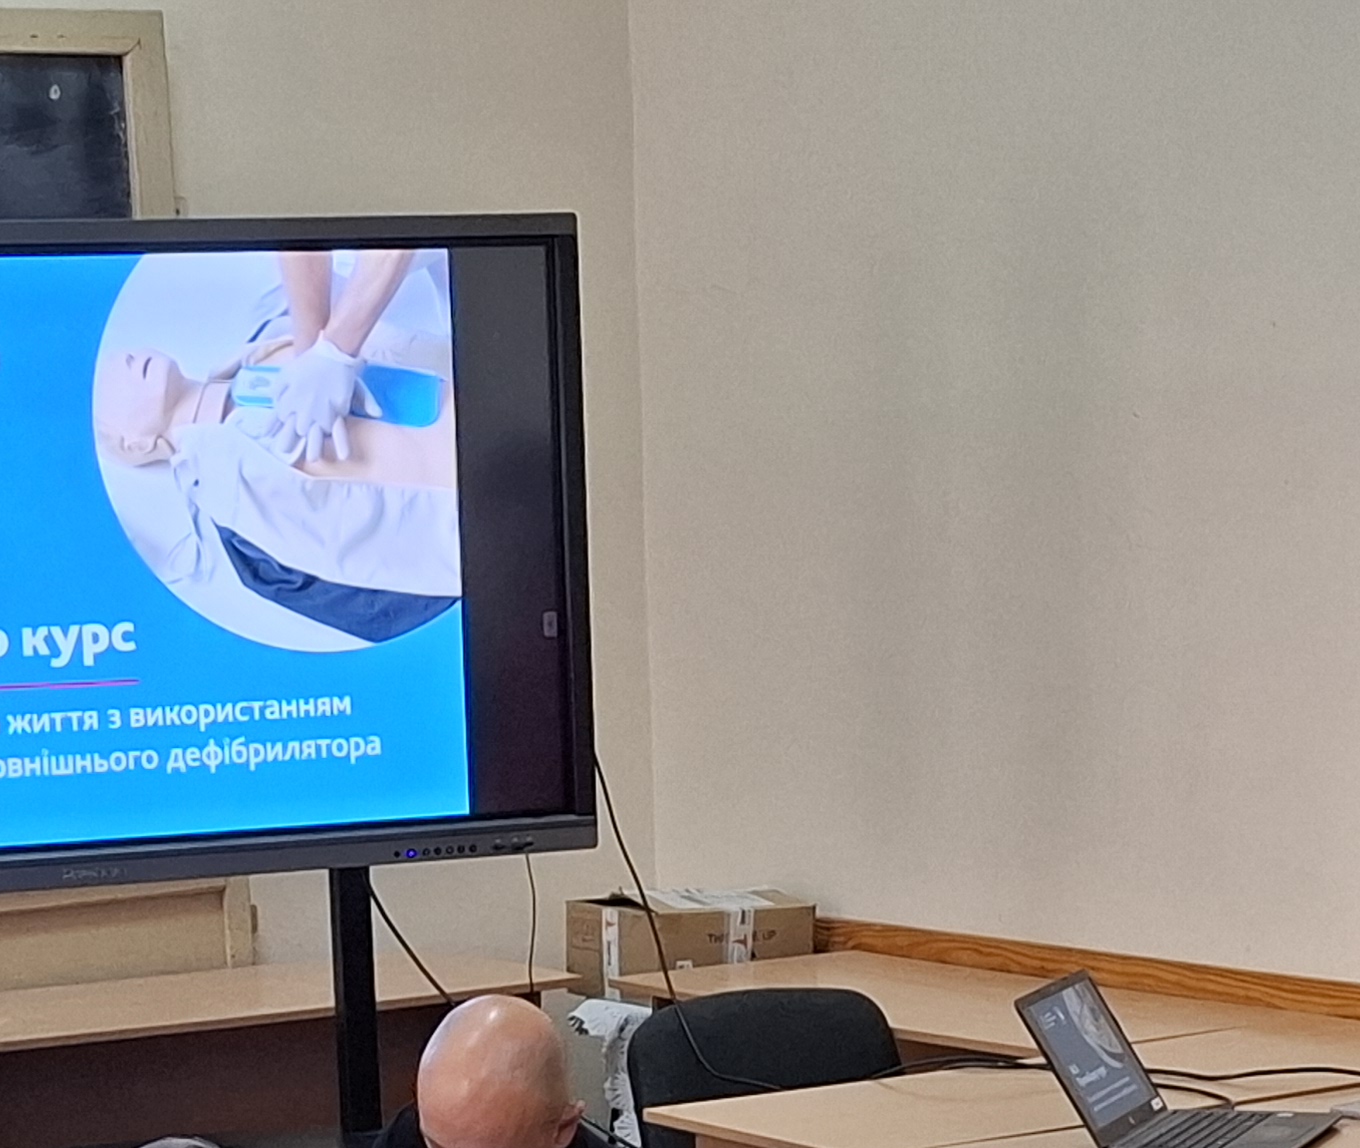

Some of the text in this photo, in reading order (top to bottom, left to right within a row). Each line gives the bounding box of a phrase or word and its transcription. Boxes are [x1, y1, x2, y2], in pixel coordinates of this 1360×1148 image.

[21, 621, 137, 668] курс
[6, 710, 99, 734] життя
[107, 708, 122, 730] з
[130, 695, 352, 732] використанням
[166, 735, 382, 774] дефібрилятора
